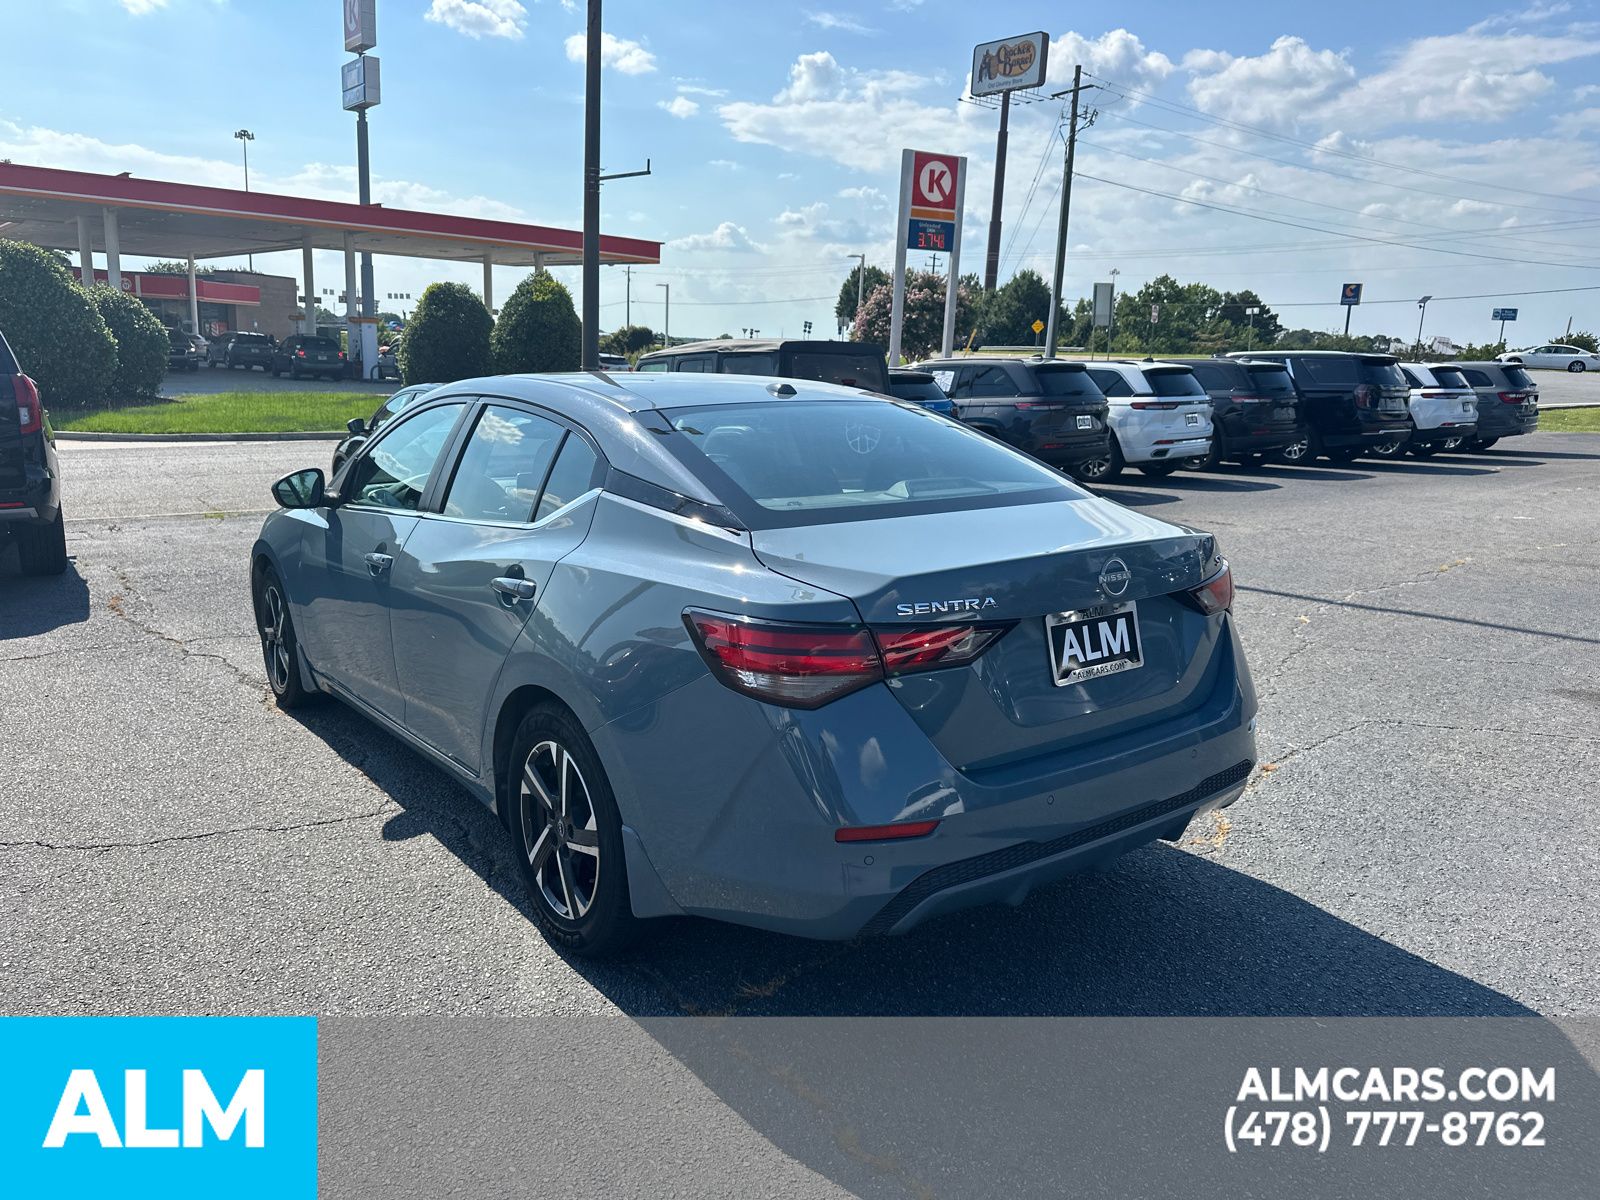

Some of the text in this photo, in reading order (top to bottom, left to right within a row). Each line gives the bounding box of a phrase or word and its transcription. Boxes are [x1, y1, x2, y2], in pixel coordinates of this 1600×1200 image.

[927, 168, 949, 202] K
[1099, 571, 1131, 583] NISSAN
[896, 597, 999, 616] SENTRA
[1082, 606, 1104, 619] ALM
[1061, 618, 1131, 667] ALM
